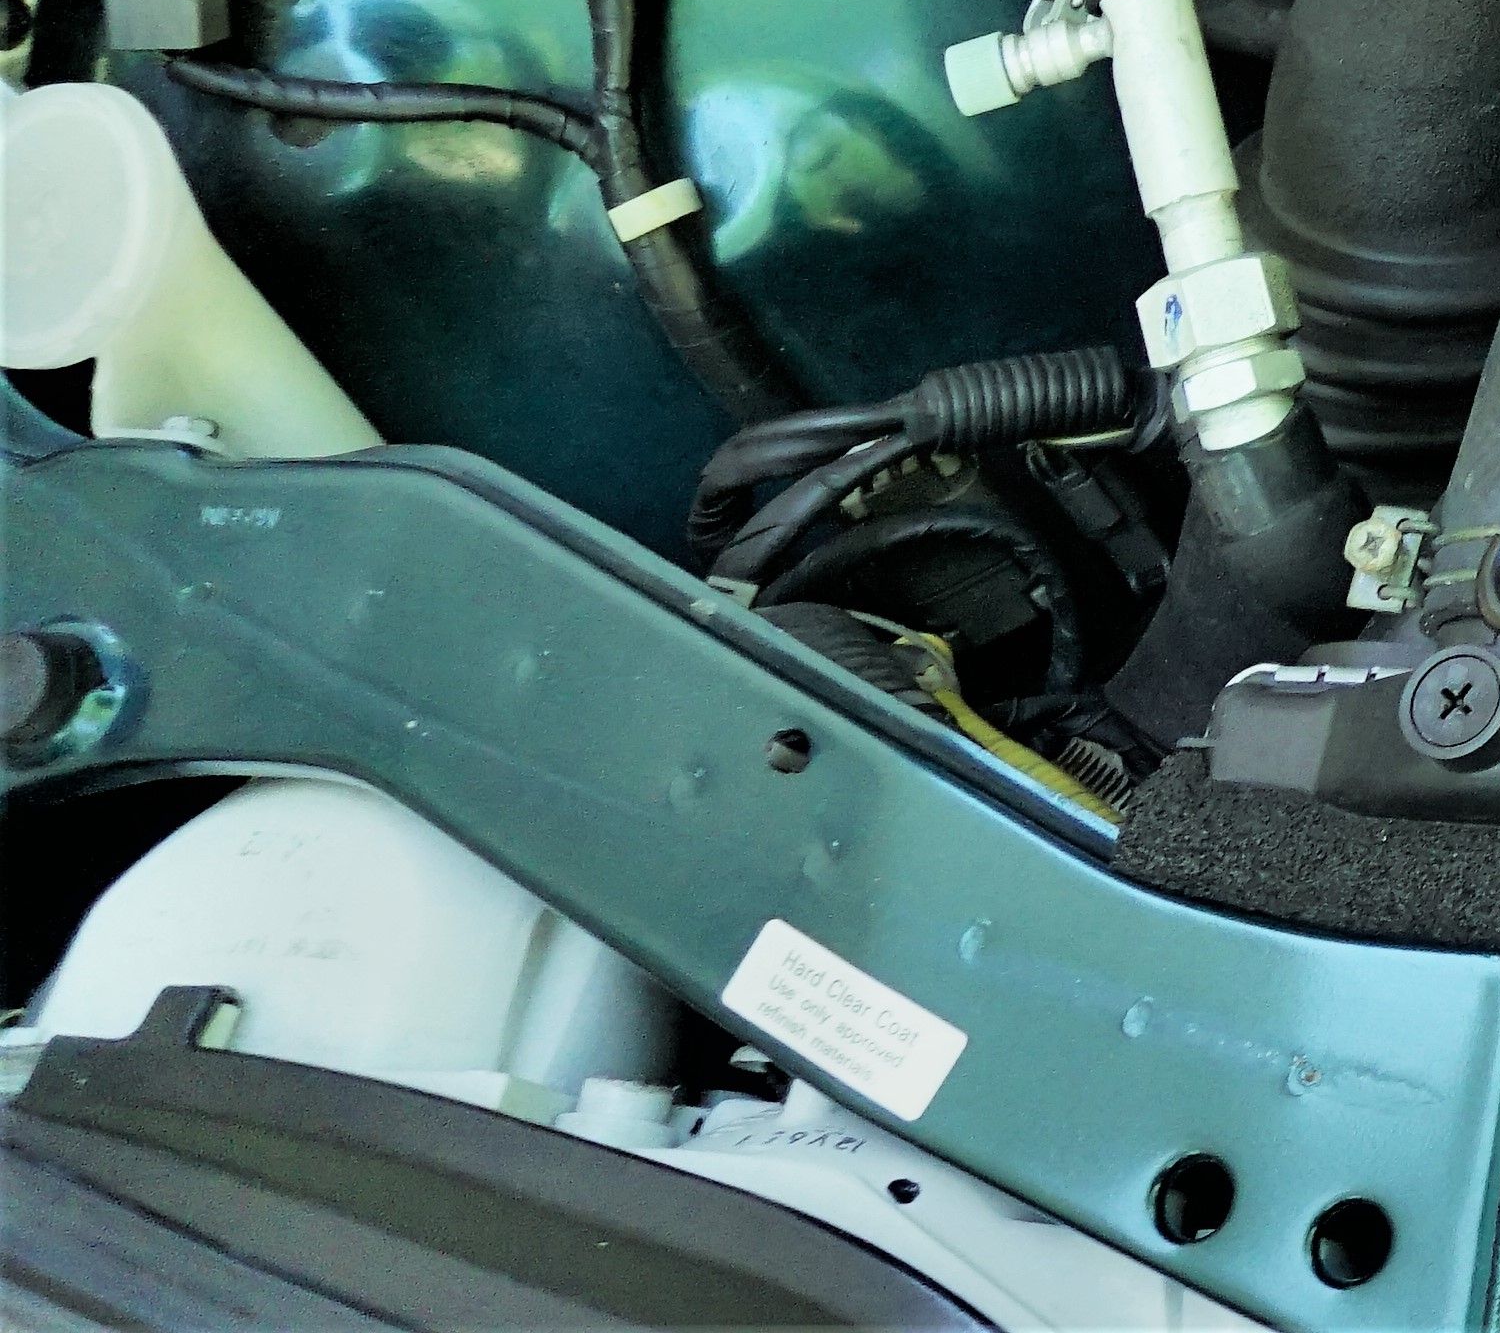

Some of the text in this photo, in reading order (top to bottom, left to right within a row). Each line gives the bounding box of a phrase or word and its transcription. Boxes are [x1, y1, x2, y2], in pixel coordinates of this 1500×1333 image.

[757, 1000, 874, 1081] refinish materials
[768, 973, 906, 1069] Use only approved
[781, 949, 921, 1047] Hard Clear Coat
